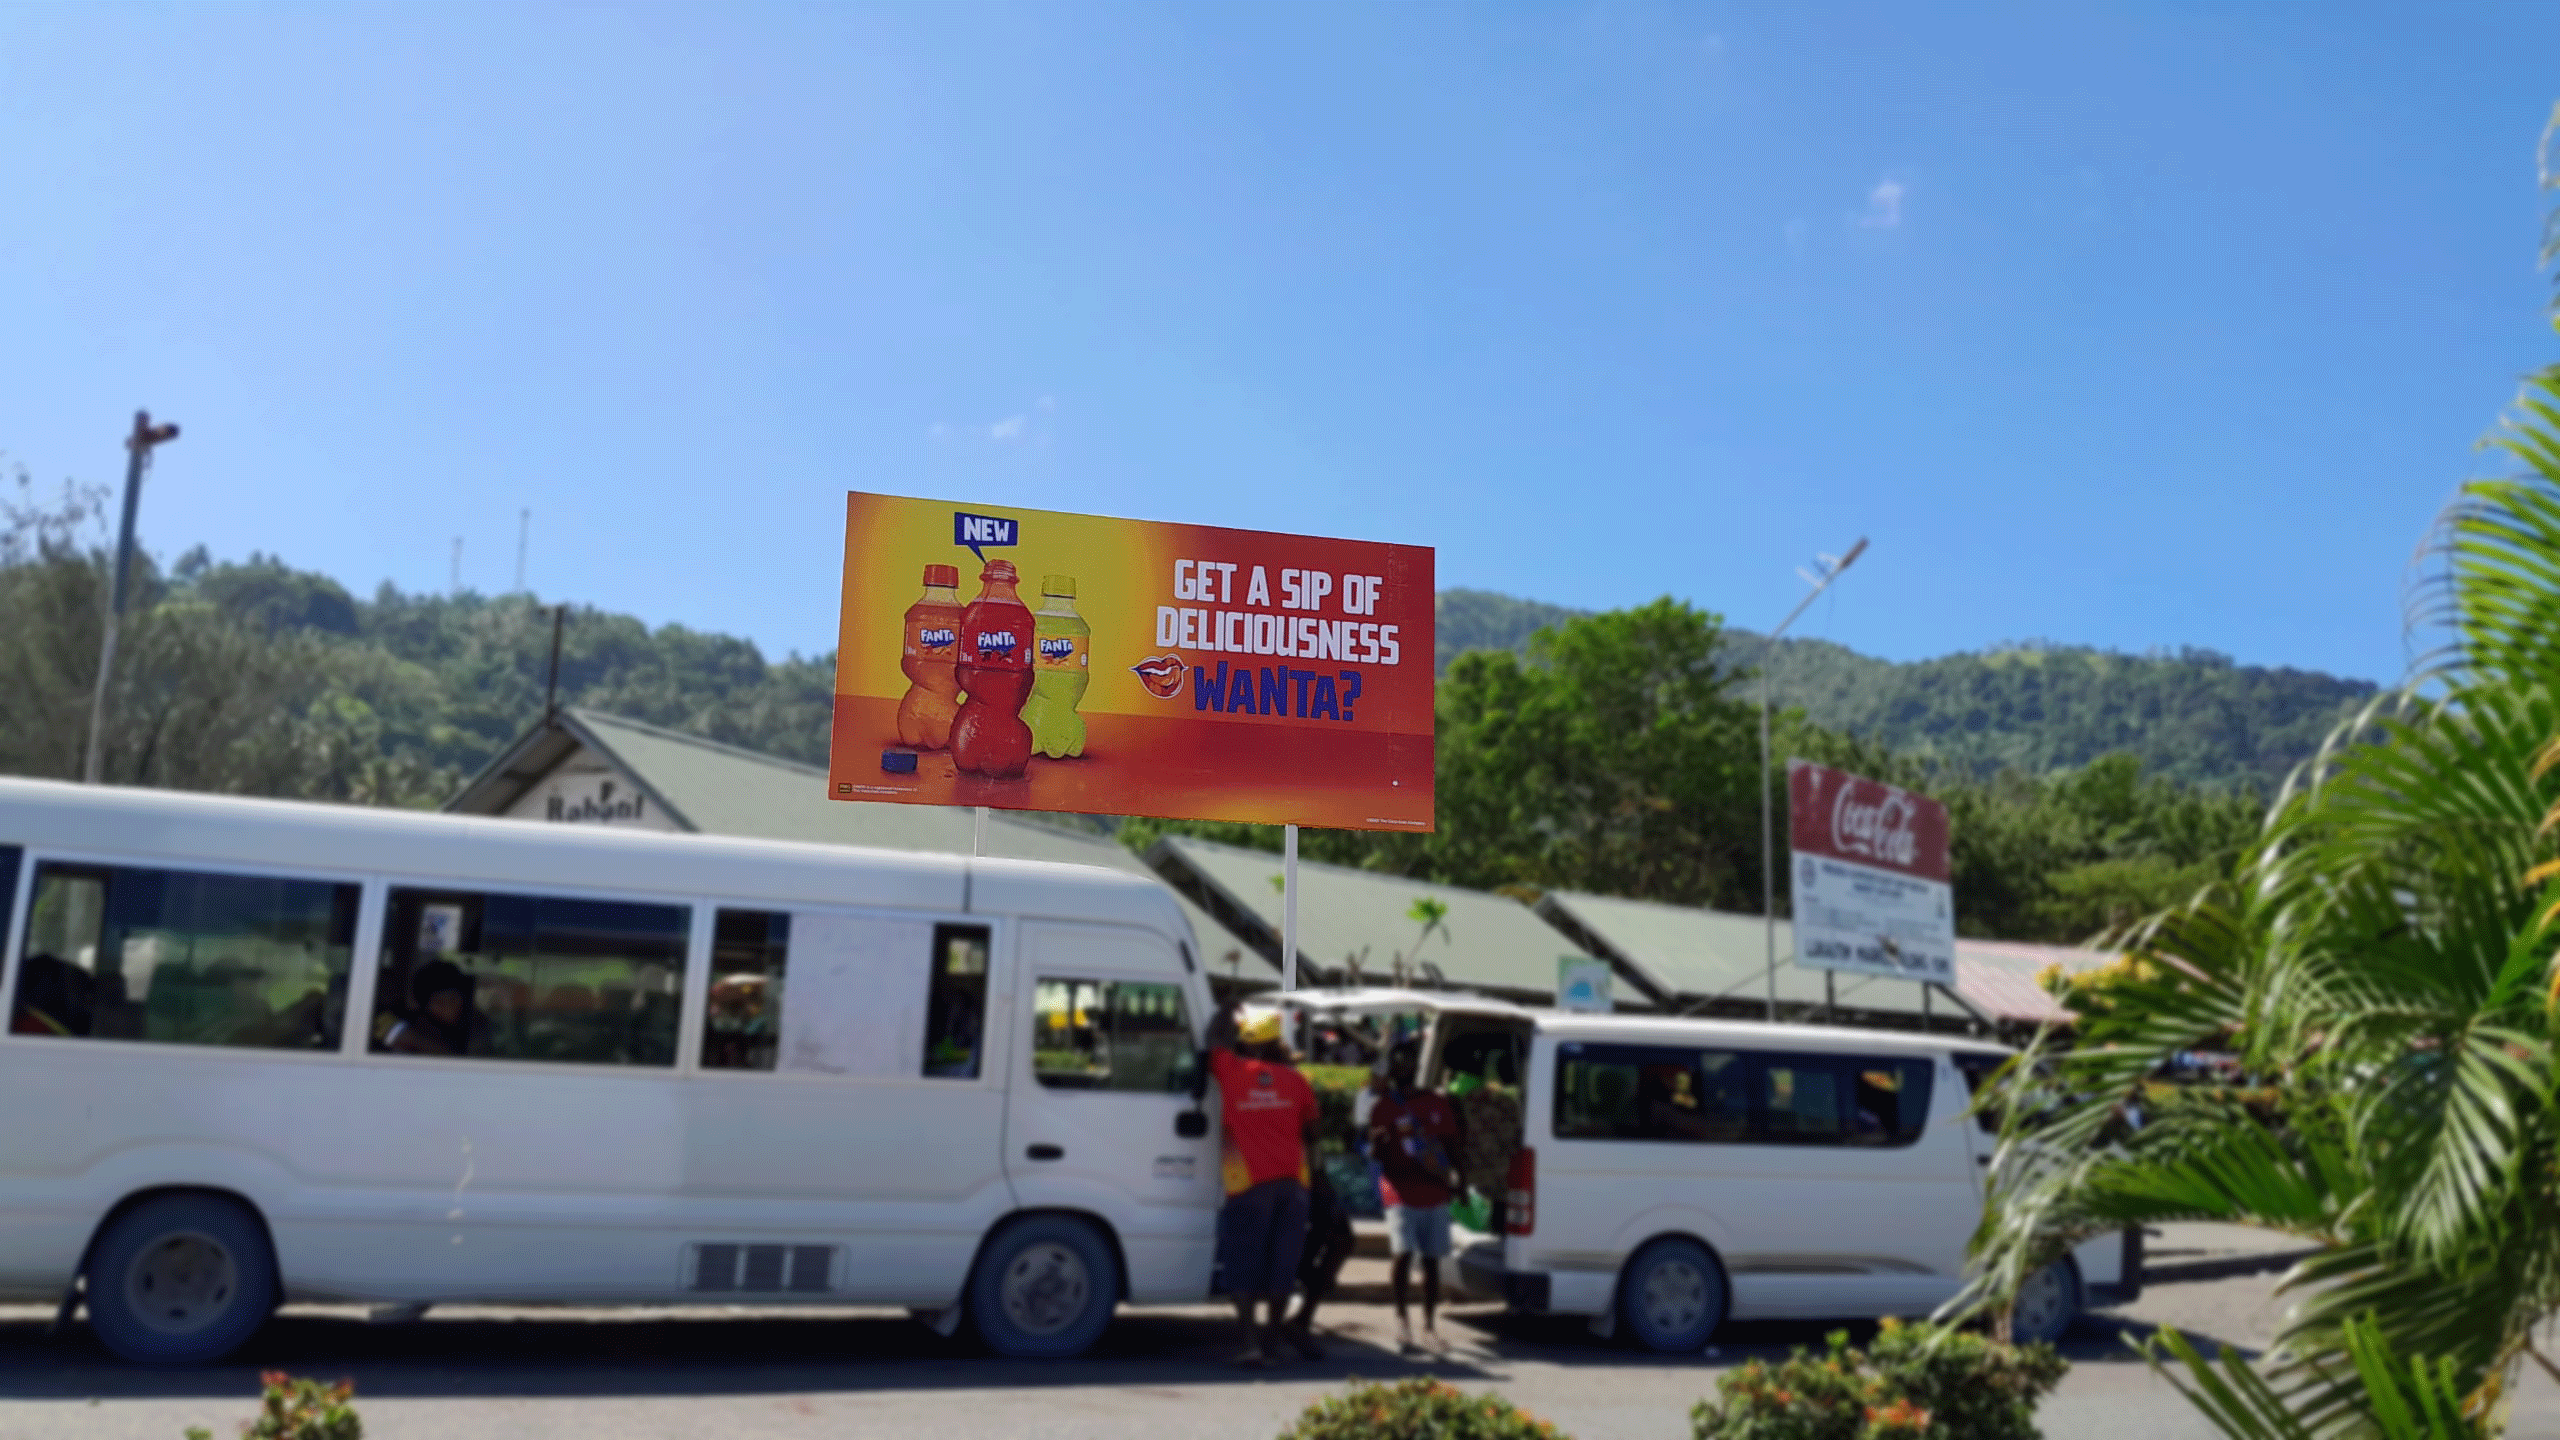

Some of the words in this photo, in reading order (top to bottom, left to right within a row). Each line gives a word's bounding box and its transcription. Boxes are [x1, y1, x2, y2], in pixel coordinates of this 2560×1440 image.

[964, 516, 1010, 542] NEW
[1174, 559, 1237, 604] GET
[1246, 565, 1271, 607] A
[1281, 568, 1332, 611] SIP
[1342, 574, 1383, 616] OF
[977, 631, 1017, 647] FANTA
[1039, 639, 1074, 653] FANTA
[1156, 605, 1400, 665] DELICIOUSNESS
[1193, 660, 1362, 721] WANTA?
